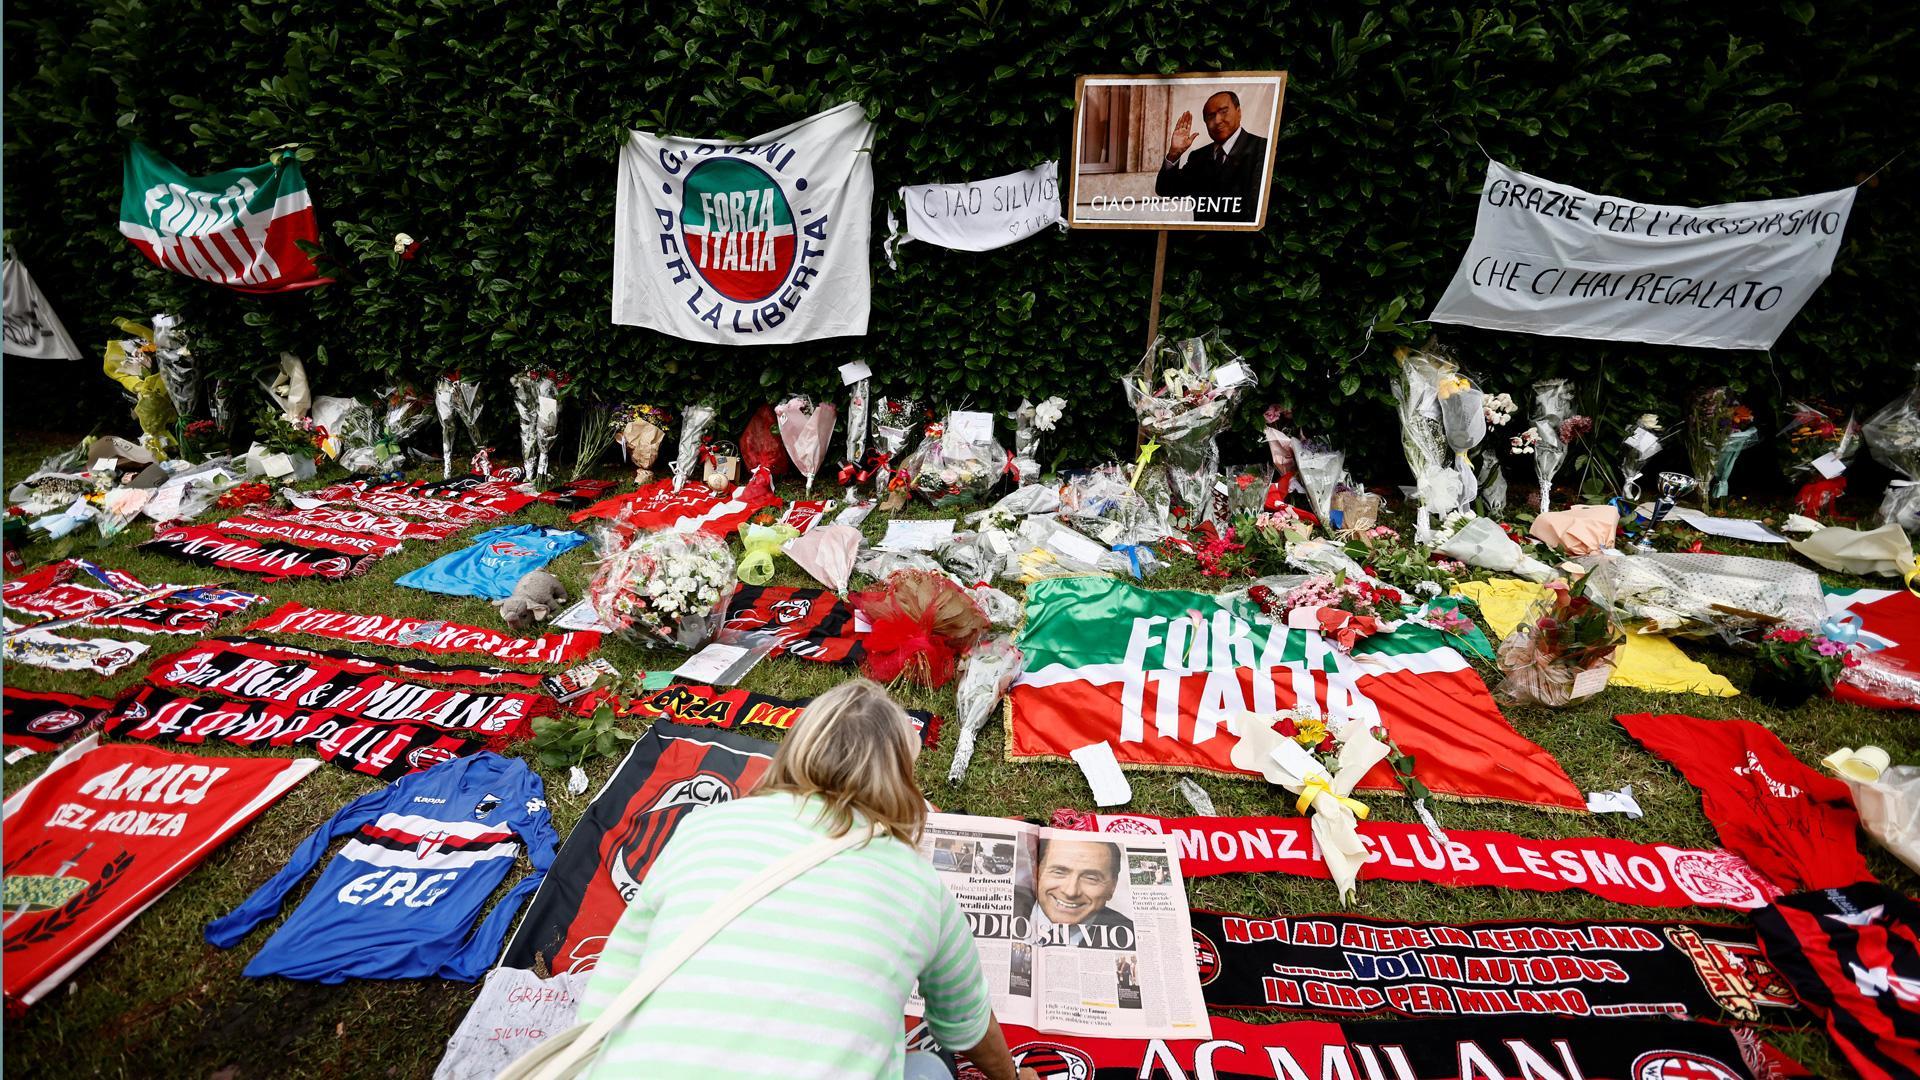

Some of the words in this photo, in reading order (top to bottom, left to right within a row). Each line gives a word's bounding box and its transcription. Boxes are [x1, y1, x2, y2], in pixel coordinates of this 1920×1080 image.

[699, 187, 775, 233] FORZA
[922, 186, 982, 219] CIAO
[992, 178, 1054, 213] SILVIO
[1090, 194, 1136, 213] CIAO
[1140, 194, 1242, 214] PRESIDENTE
[1488, 179, 1586, 222] GRAZIE
[1593, 199, 1647, 234] PER
[654, 207, 692, 285] PER
[687, 285, 725, 329] LA
[699, 230, 777, 272] ITALIA
[1471, 256, 1531, 288] CHE
[1531, 268, 1565, 296] CI
[1568, 270, 1622, 298] HAI
[1625, 273, 1783, 311] REGALATO
[1124, 609, 1340, 673] FORZA
[216, 659, 318, 701] FIGA
[295, 682, 330, 708] &
[347, 679, 504, 730] MILAN
[1120, 664, 1381, 745] ITALIA
[307, 719, 411, 769] PELLE
[77, 762, 231, 804] AMICI
[413, 796, 447, 805] Kappa
[667, 781, 729, 805] ACM
[45, 803, 96, 829] DEL
[90, 810, 188, 837] MONZA
[1171, 826, 1323, 863] MONZ
[1357, 833, 1480, 873] CLUB
[1485, 842, 1666, 893] LESMO
[337, 869, 460, 909] ERG
[956, 892, 988, 901] Domani
[988, 893, 1003, 901] alle
[968, 877, 1013, 885] Berlusconi,
[991, 903, 1012, 911] Stato
[1222, 916, 1289, 944] NOI
[1291, 921, 1337, 947] AD
[1340, 922, 1435, 952] ATENE
[1429, 926, 1477, 948] IN
[1475, 926, 1665, 952] AEROPLANO
[1423, 955, 1465, 983] IN
[1465, 956, 1630, 984] AUTOBUS
[1262, 976, 1303, 1006] IN
[1304, 982, 1386, 1008] GIRO
[1385, 983, 1453, 1014] PER
[488, 1026, 545, 1042] SILVIO
